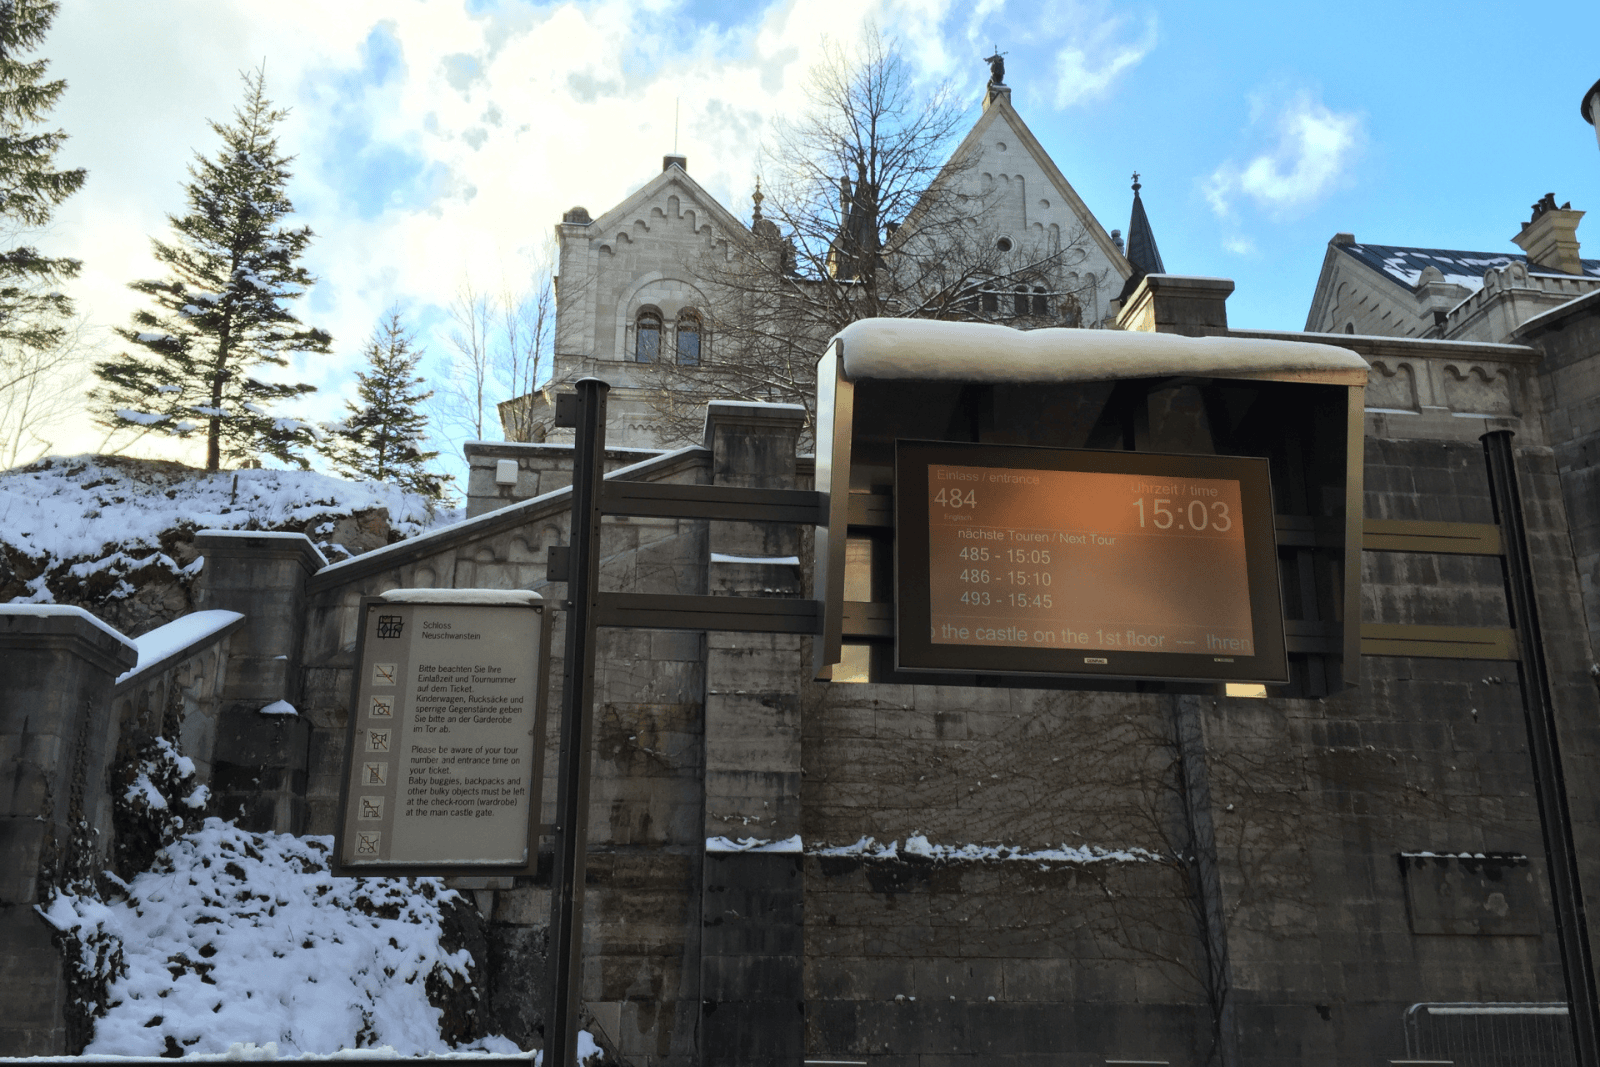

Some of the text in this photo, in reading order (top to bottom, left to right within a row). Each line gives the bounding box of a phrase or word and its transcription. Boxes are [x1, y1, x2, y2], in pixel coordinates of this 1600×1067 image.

[937, 469, 979, 482] Einlass
[989, 473, 1039, 484] entrance
[1190, 485, 1218, 497] time
[934, 488, 977, 509] 484
[1132, 498, 1232, 532] 15:03
[958, 528, 1004, 540] nächste
[1008, 530, 1049, 542] Touren
[1059, 533, 1086, 544] Next
[1090, 533, 1116, 545] Tour
[959, 546, 990, 562] 485
[1007, 549, 1051, 564] 15:05
[960, 568, 990, 584] 486
[1008, 571, 1052, 587] 15:10
[960, 591, 991, 606] 493
[1008, 593, 1052, 609] 15:45
[423, 620, 452, 629] Schloss
[422, 631, 481, 640] Neuschwanstein
[942, 624, 969, 640] the
[976, 626, 1028, 641] castle
[1034, 630, 1055, 643] on
[1062, 628, 1089, 644] the
[1096, 629, 1121, 645] 1st
[1126, 630, 1165, 647] floor
[1207, 633, 1250, 650] Ihren
[419, 664, 436, 673] Bitte
[418, 675, 453, 683] Einlaßzeit
[471, 675, 516, 683] Tournummer
[417, 684, 429, 692] auf
[450, 685, 474, 693] Ticket.
[416, 695, 466, 704] Kinderwagen,
[416, 705, 522, 715] sperrige Gegenstände geben
[474, 716, 512, 724] Garderobe
[411, 746, 436, 754] Please
[439, 746, 448, 754] be
[442, 756, 455, 764] and
[409, 777, 428, 786] Baby
[430, 777, 462, 786] buggies,
[465, 777, 505, 786] backpacks
[430, 788, 450, 796] bulky
[452, 788, 479, 797] objects
[513, 788, 525, 796] left
[477, 798, 518, 806] (wardrobe)
[450, 809, 473, 817] castle
[475, 810, 494, 818] gate.
